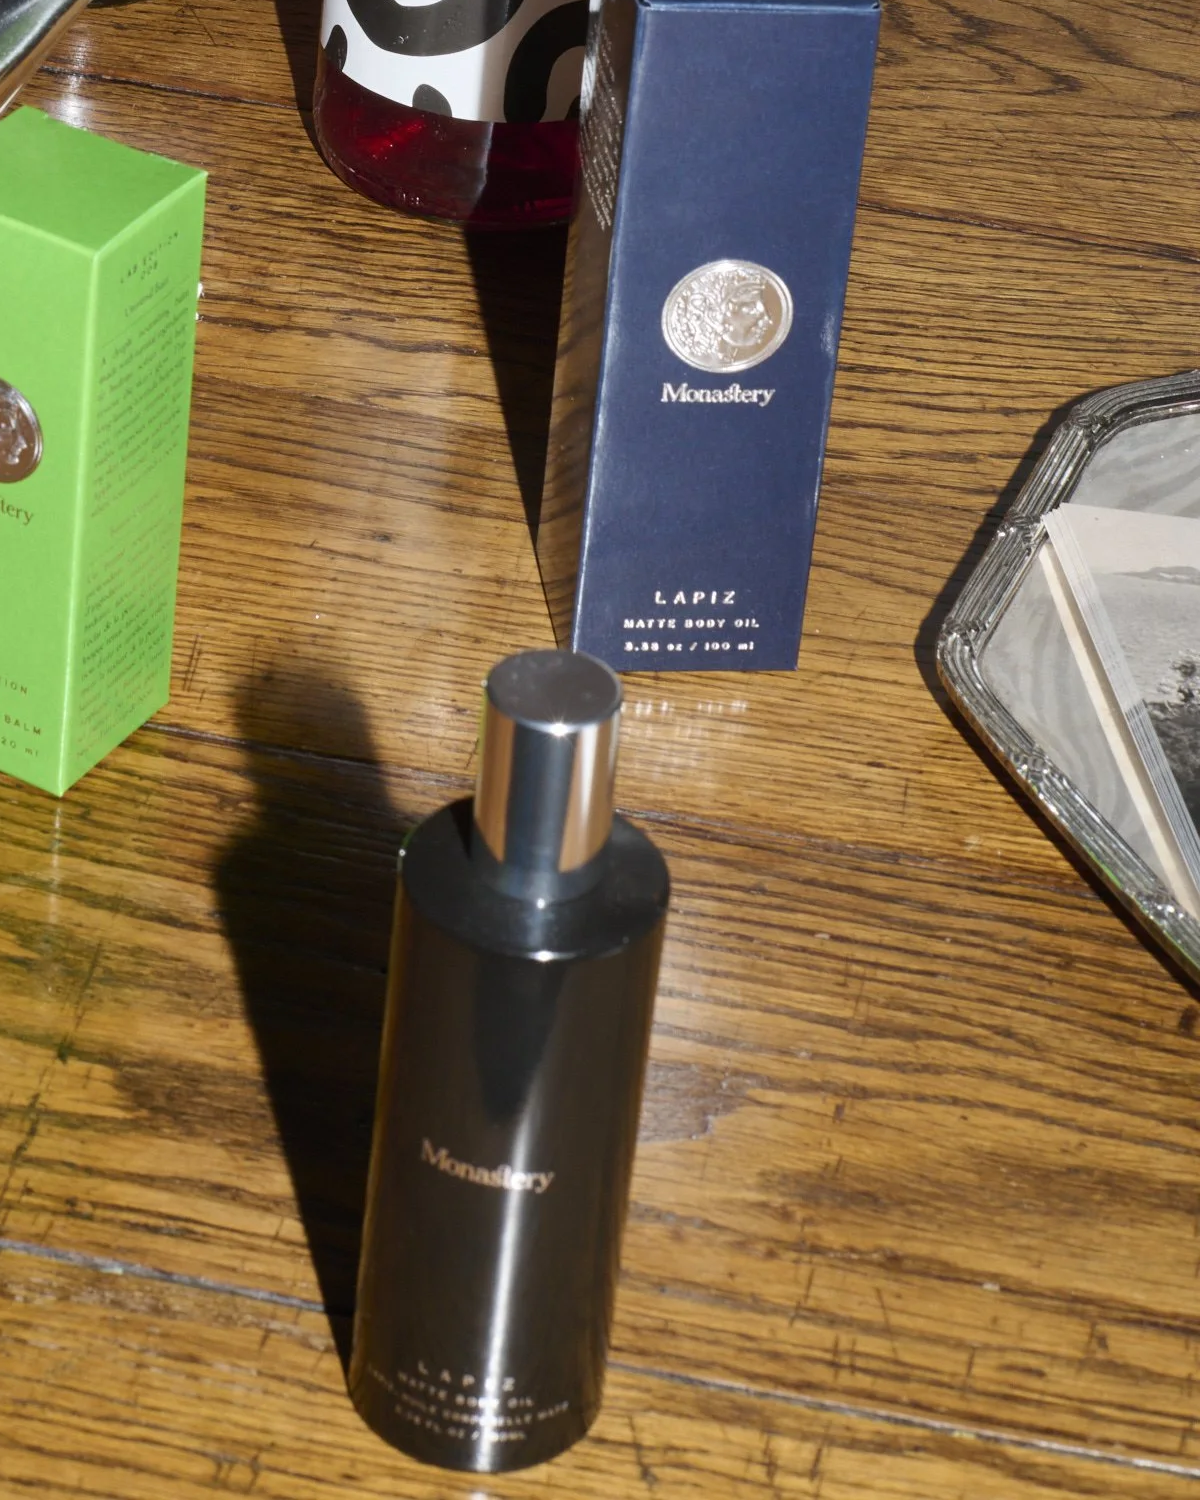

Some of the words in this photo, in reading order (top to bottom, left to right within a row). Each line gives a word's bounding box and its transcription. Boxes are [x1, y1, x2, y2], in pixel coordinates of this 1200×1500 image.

[660, 381, 776, 407] Monastery
[654, 590, 736, 605] LAPIZ
[623, 618, 676, 629] MATTE
[684, 618, 726, 629] BODY
[734, 617, 760, 628] OIL
[704, 641, 731, 651] 100
[4, 714, 42, 736] BALM
[420, 1136, 556, 1194] Monastery
[417, 1359, 516, 1392] LAPIZ
